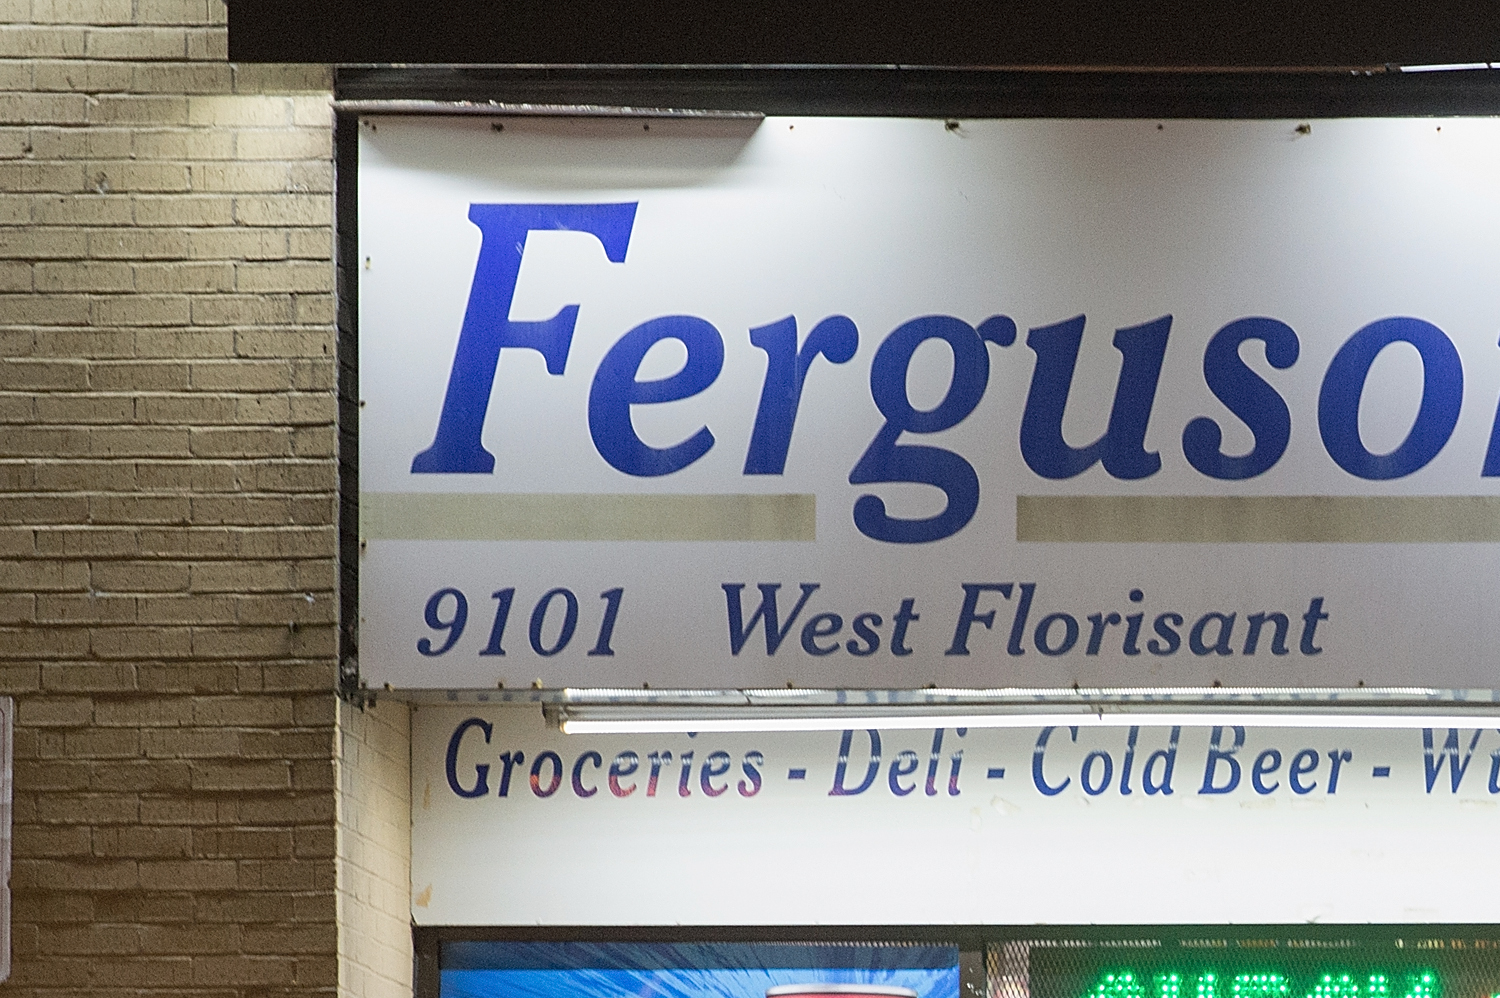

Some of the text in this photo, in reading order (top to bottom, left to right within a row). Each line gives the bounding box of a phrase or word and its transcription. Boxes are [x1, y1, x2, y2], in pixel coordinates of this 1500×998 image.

[416, 581, 1330, 658] 9101 West Florisant
[445, 717, 764, 799] Groceries
[828, 727, 968, 798] Deli
[1031, 725, 1180, 797] Cold
[1199, 725, 1354, 797] Beer
